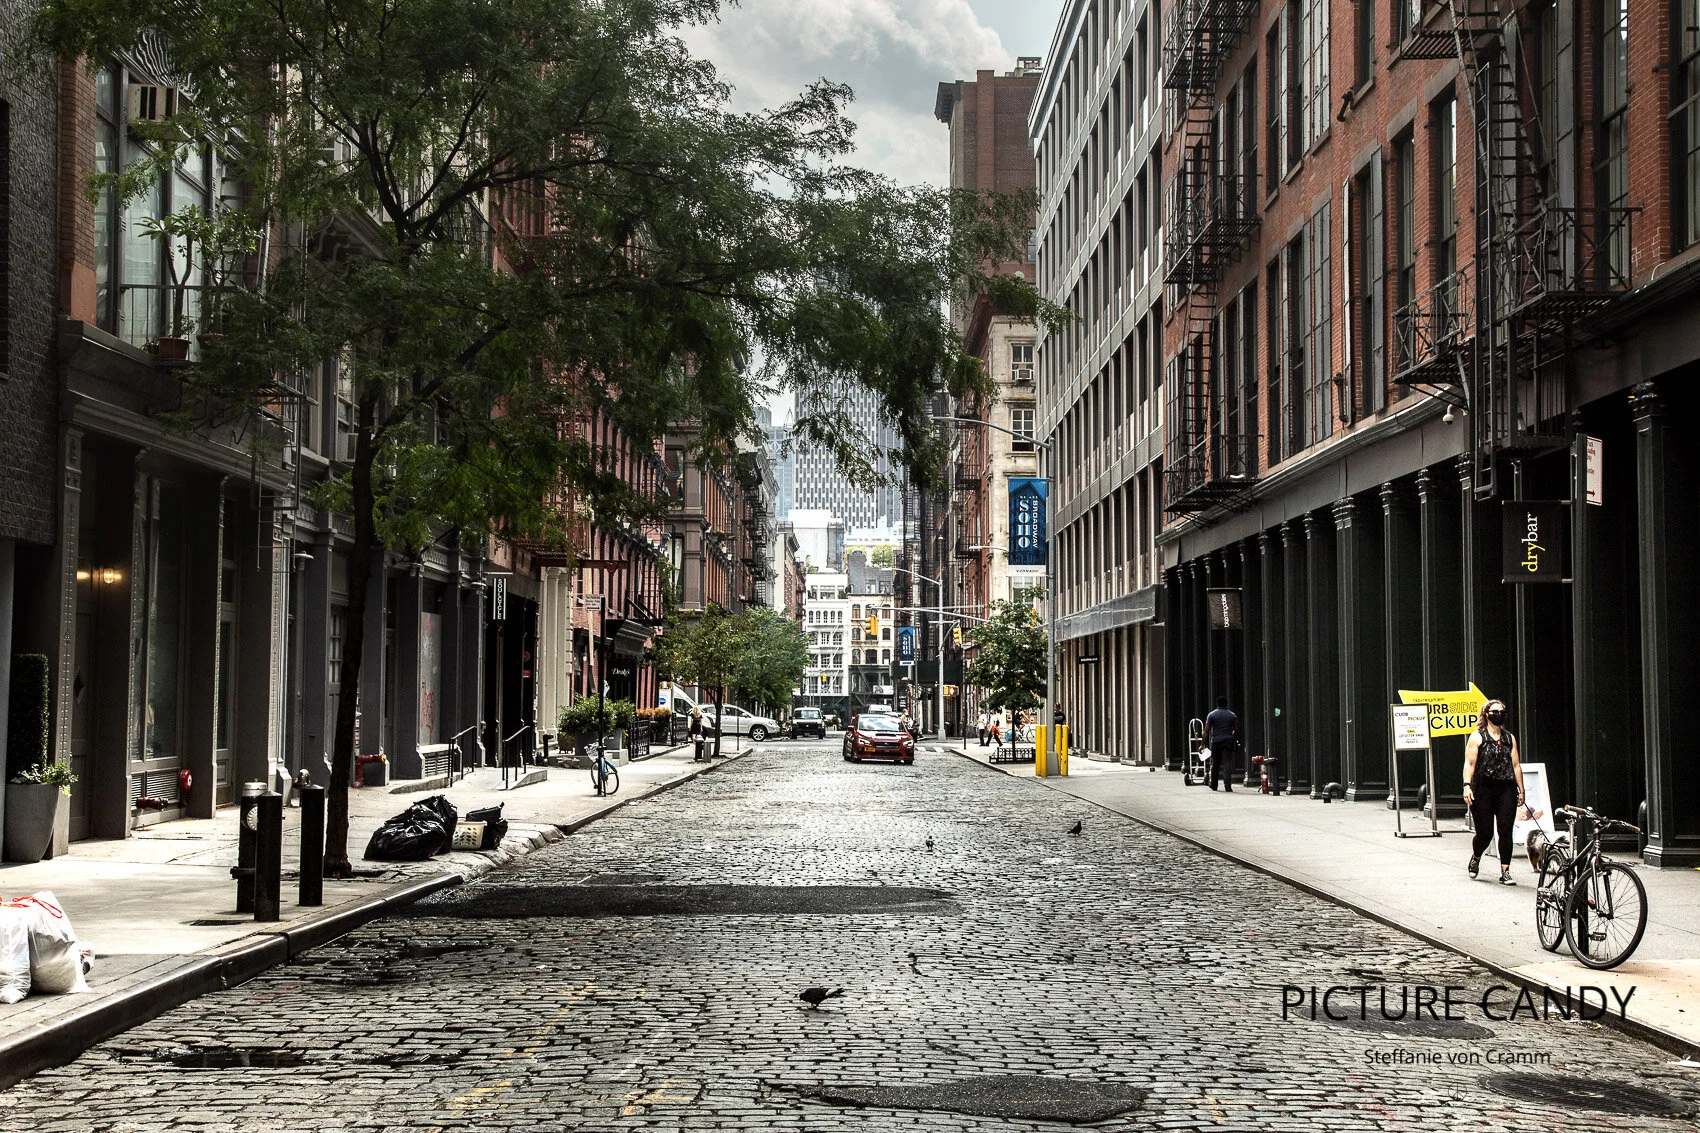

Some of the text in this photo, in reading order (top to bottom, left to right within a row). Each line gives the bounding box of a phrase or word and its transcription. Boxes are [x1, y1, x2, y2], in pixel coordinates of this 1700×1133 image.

[1018, 500, 1031, 548] SOHO
[1521, 511, 1546, 573] drybar
[1430, 714, 1478, 730] CKUP
